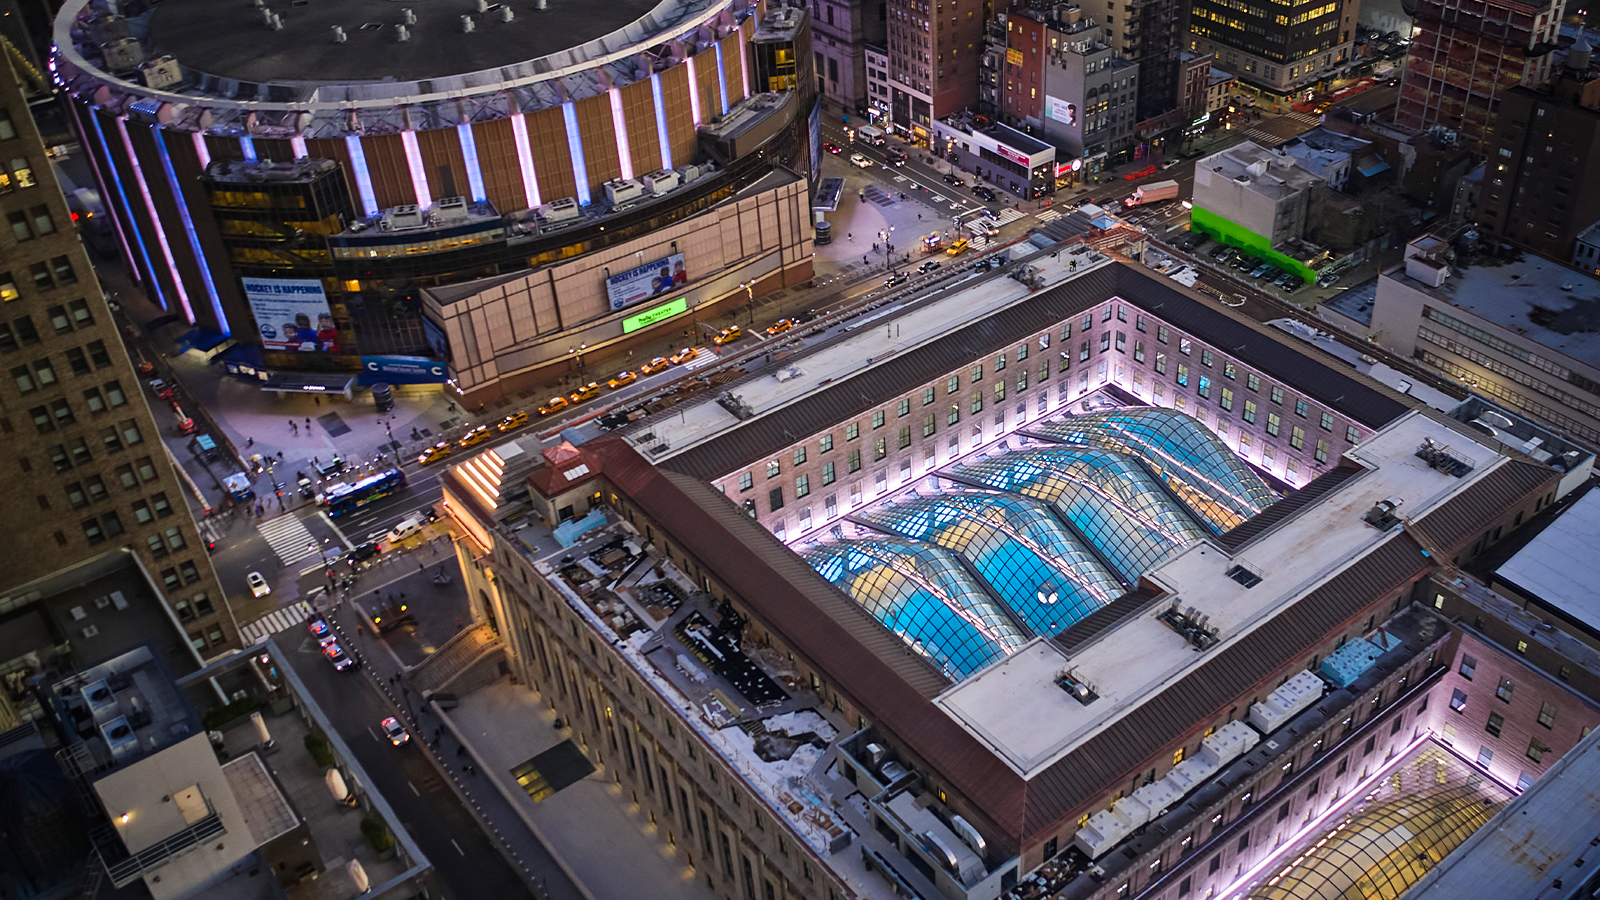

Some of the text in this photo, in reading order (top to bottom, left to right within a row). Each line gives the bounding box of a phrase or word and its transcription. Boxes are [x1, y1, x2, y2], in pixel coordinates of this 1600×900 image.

[611, 271, 633, 285] HOCKEY
[639, 259, 670, 275] HAPPENING
[245, 284, 322, 294] HOCKEY IS HAPPENING
[638, 315, 651, 323] hulu
[652, 307, 672, 317] THEATER
